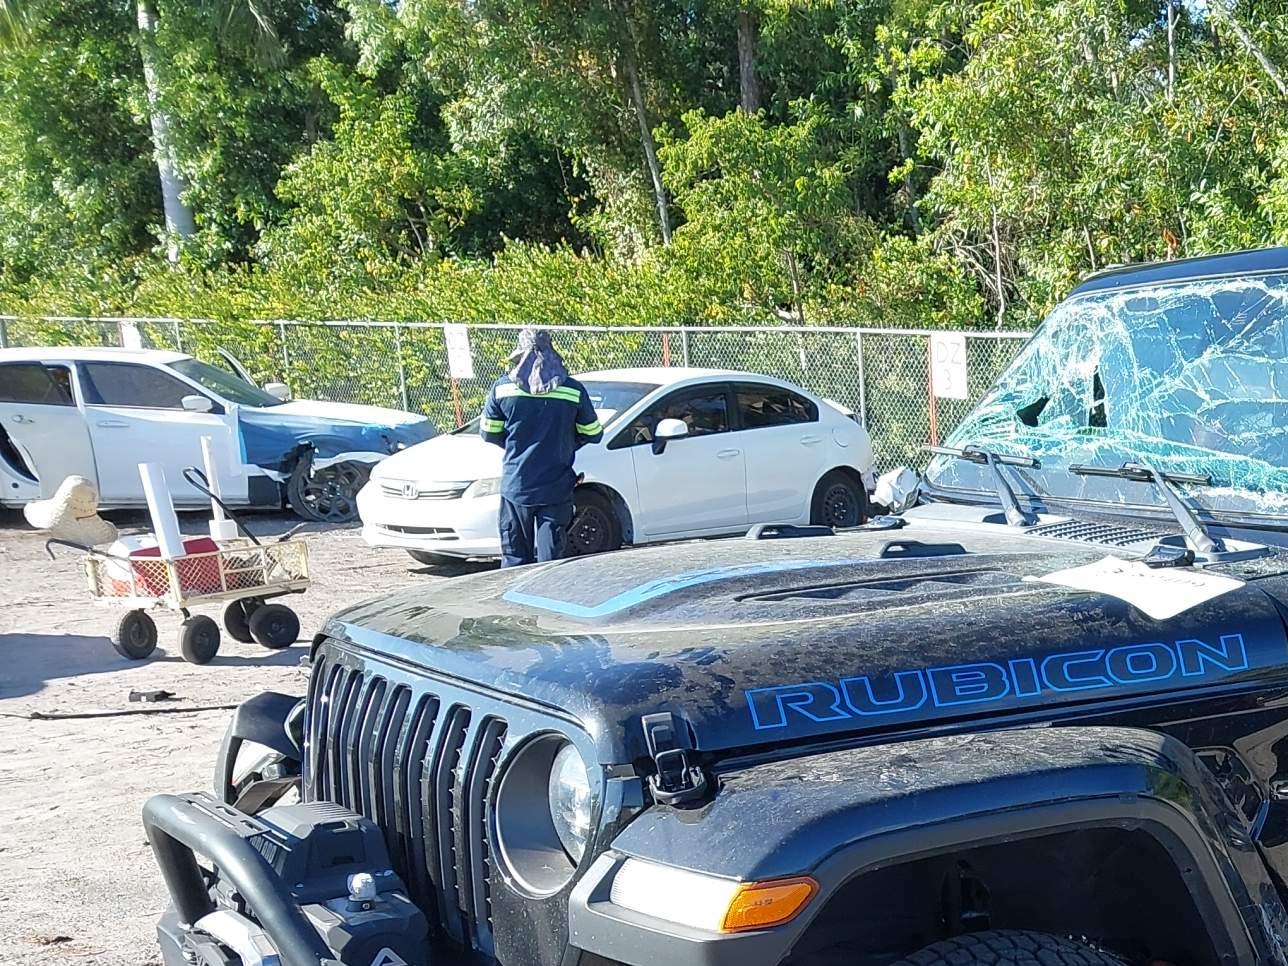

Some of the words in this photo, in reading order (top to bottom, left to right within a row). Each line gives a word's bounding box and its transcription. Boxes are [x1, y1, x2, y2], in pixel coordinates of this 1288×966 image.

[937, 341, 961, 365] DZ
[944, 368, 952, 390] 3
[747, 634, 1248, 730] RUBICON
